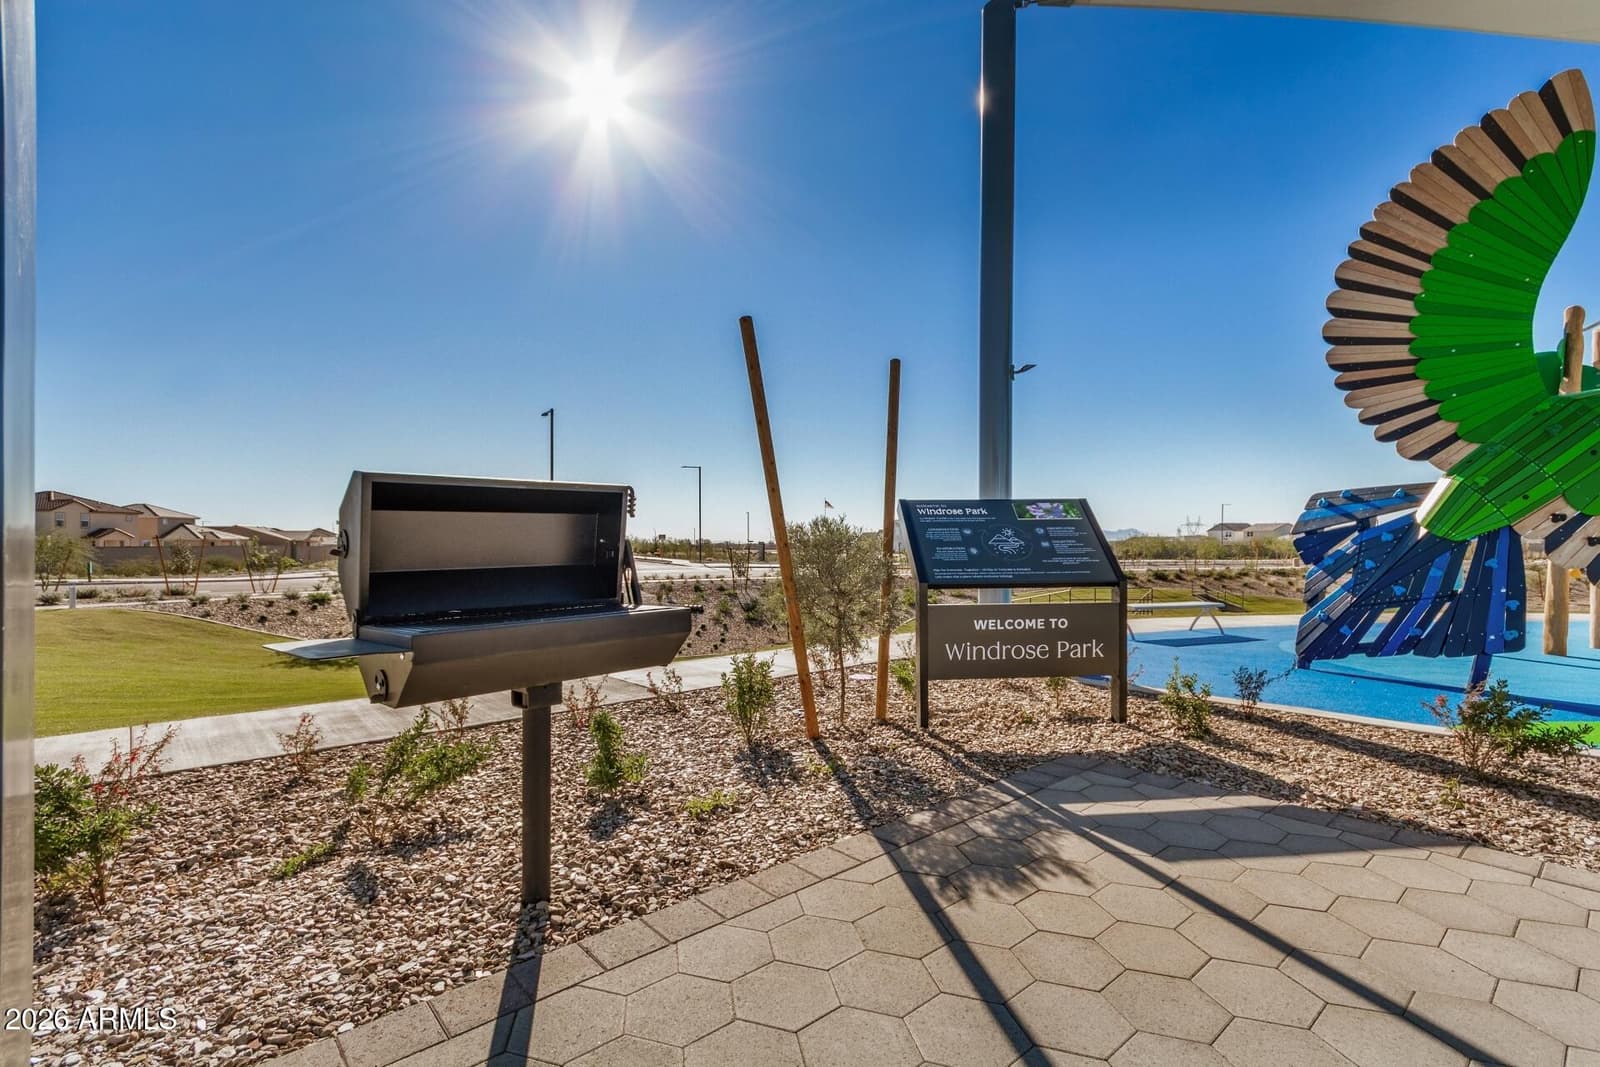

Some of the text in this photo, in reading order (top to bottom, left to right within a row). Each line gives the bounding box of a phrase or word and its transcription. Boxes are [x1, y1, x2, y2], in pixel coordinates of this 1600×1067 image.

[916, 507, 963, 516] Windrose
[974, 618, 1068, 630] WELCOME TO
[945, 639, 1104, 661] Windrose Park
